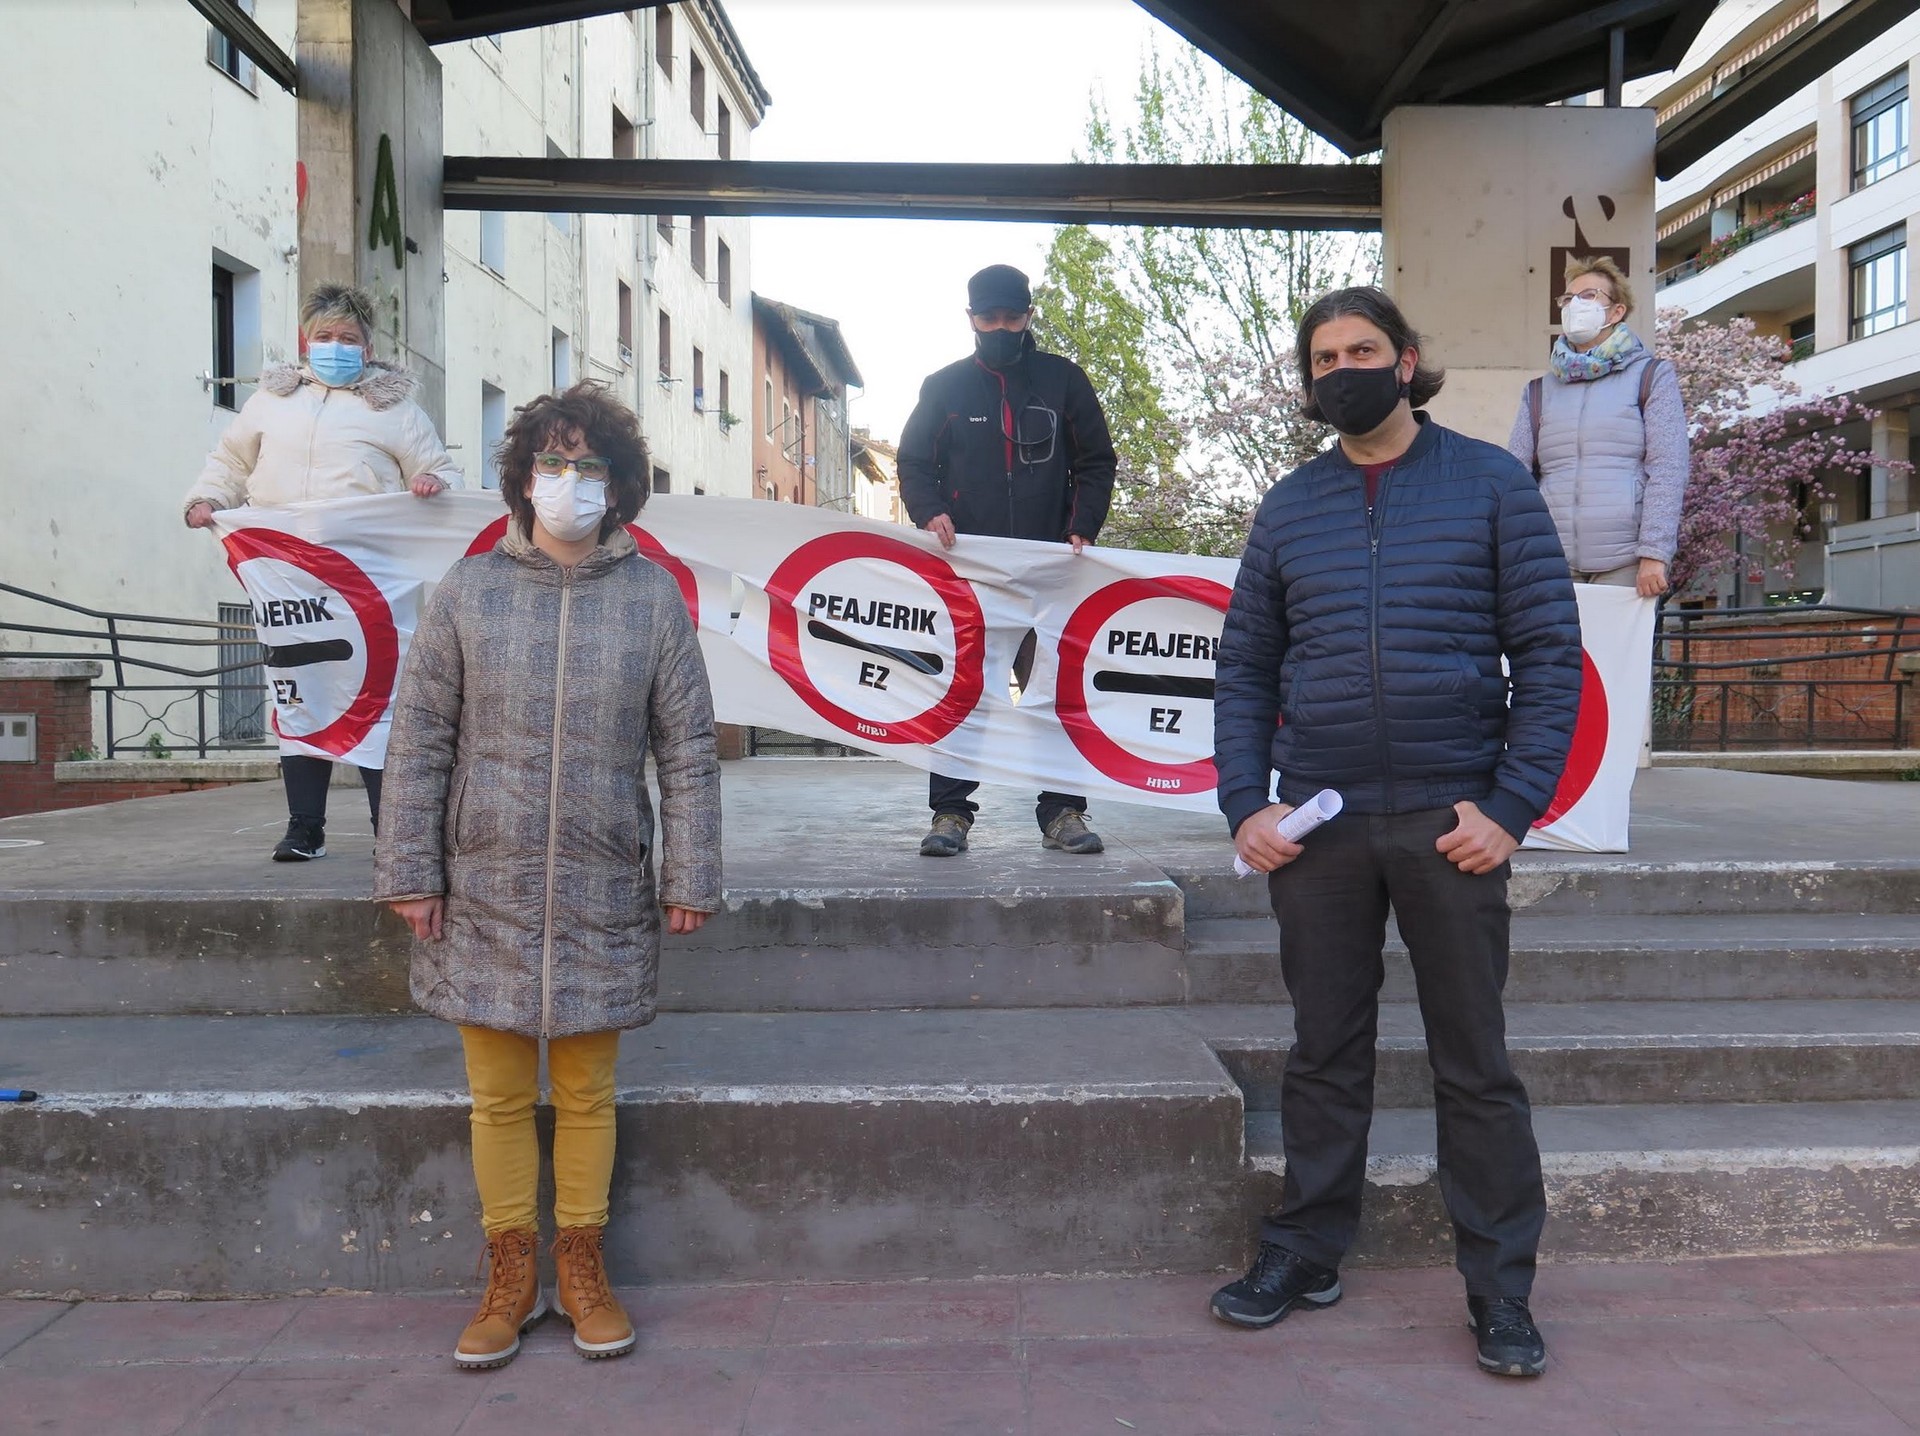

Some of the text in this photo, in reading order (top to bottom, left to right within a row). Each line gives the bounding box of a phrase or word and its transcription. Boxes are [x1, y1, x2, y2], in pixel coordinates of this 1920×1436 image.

[255, 596, 334, 628] JERIK
[808, 592, 938, 635] PEAJERIK
[1107, 630, 1219, 661] PEAJERI
[858, 661, 890, 691] EZ
[273, 680, 304, 704] EZ
[856, 722, 888, 737] HIRU
[1149, 708, 1182, 734] EZ
[1146, 777, 1181, 789] HIRU
